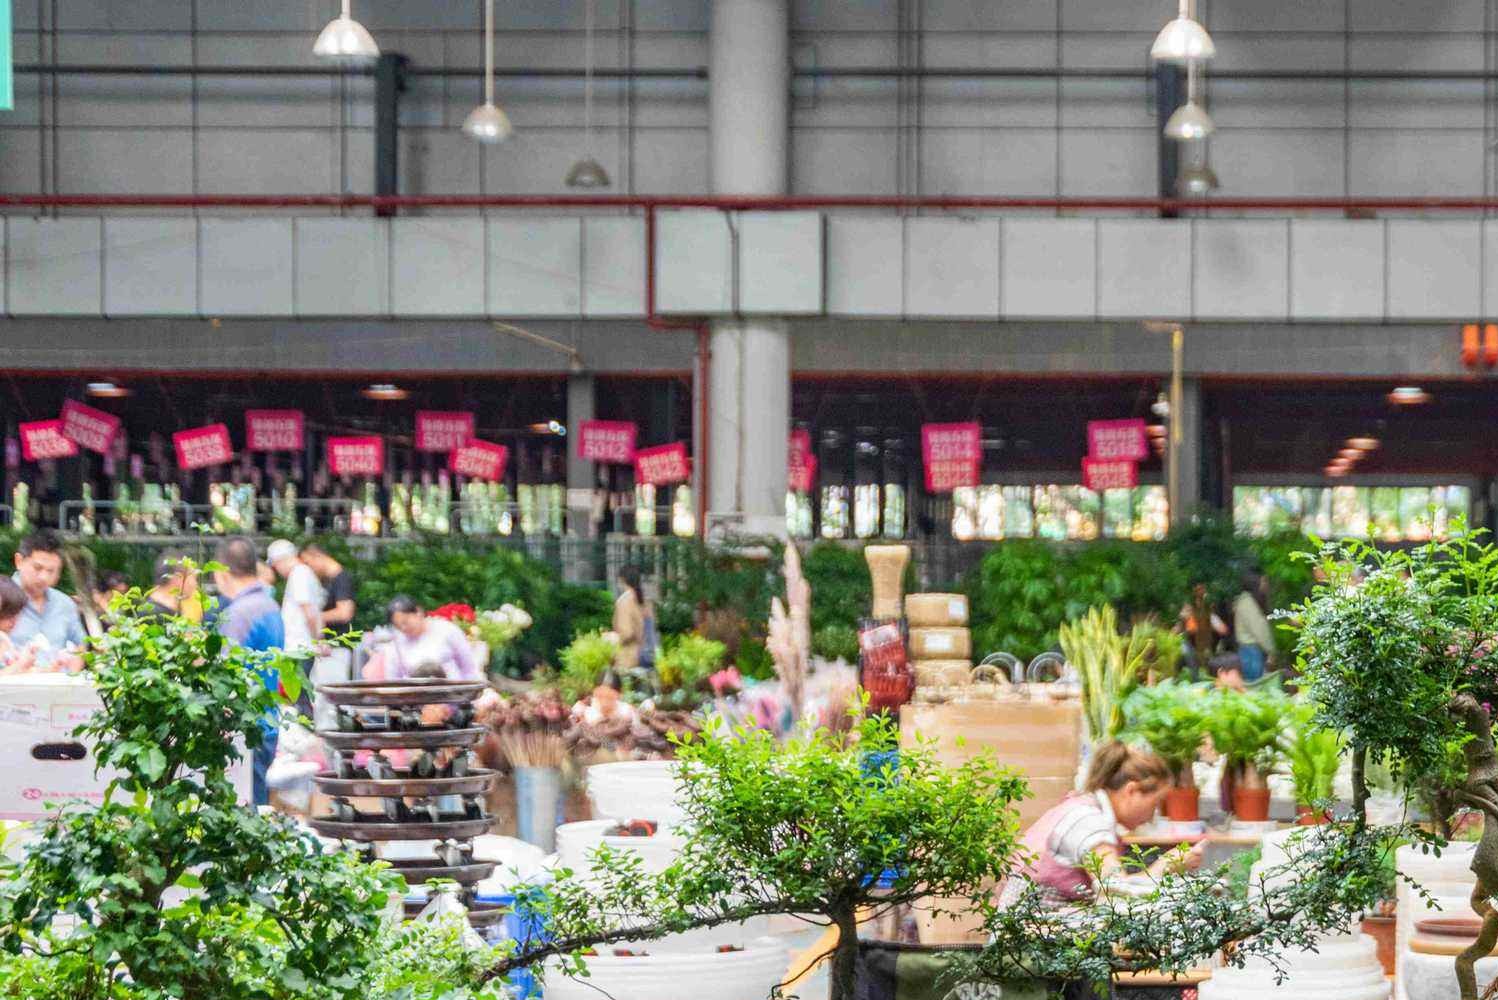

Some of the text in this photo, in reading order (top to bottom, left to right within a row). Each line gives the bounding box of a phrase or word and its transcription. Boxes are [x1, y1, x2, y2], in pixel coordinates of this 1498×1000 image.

[254, 431, 296, 448] 5010
[424, 432, 464, 450] 5011
[584, 440, 626, 460] 5012
[335, 455, 376, 472] 5040
